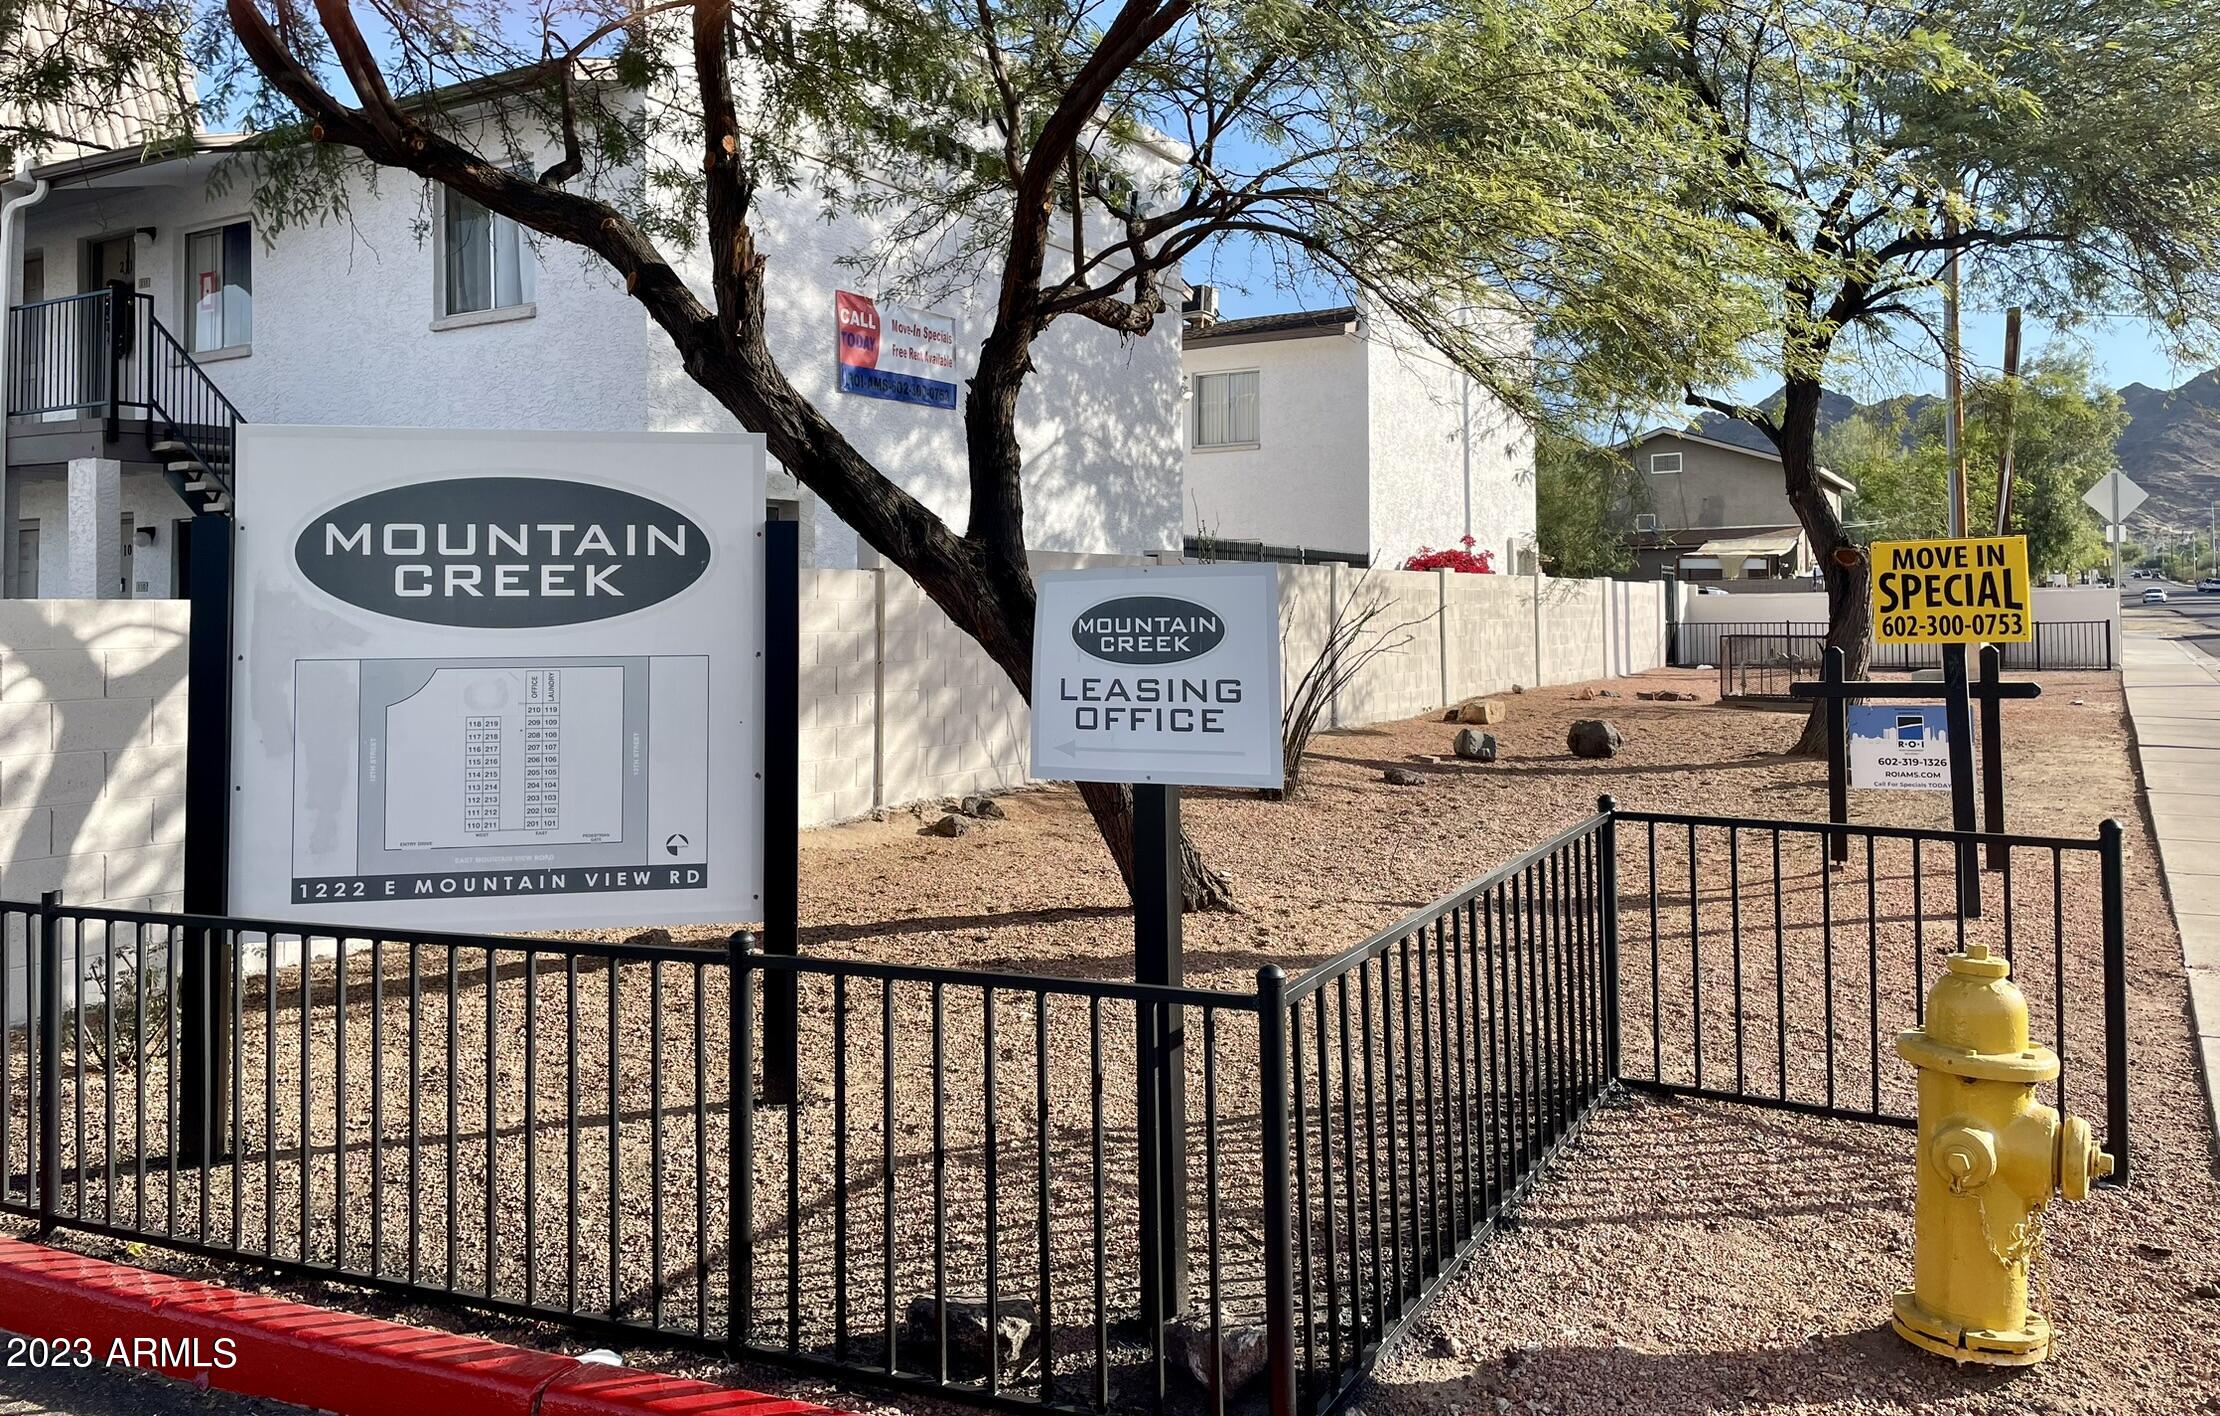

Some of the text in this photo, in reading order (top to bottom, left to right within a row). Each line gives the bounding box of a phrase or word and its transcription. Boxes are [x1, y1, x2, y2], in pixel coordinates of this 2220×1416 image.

[840, 308, 876, 329] CALL
[841, 331, 876, 351] TODAY
[892, 319, 953, 345] Move-In Specials
[892, 344, 907, 358] Free
[924, 351, 953, 368] Available
[325, 522, 686, 556] MOUNTAIN
[1892, 544, 2006, 571] MOVE IN
[394, 564, 625, 597] CREEK
[1878, 567, 2024, 614] SPECIAL
[1077, 616, 1216, 634] MOUNTAIN
[1882, 613, 2023, 637] 602-300-0753
[1100, 636, 1191, 652] CREEK
[1060, 677, 1242, 703] LEASING
[545, 718, 557, 726] 109
[1075, 706, 1225, 733] OFFICE
[1878, 757, 1948, 767] 602-319-1326
[1885, 771, 1941, 779] ROIAMS.COM
[299, 870, 700, 899] 1222 E MOUNTAIN VIEW RD
